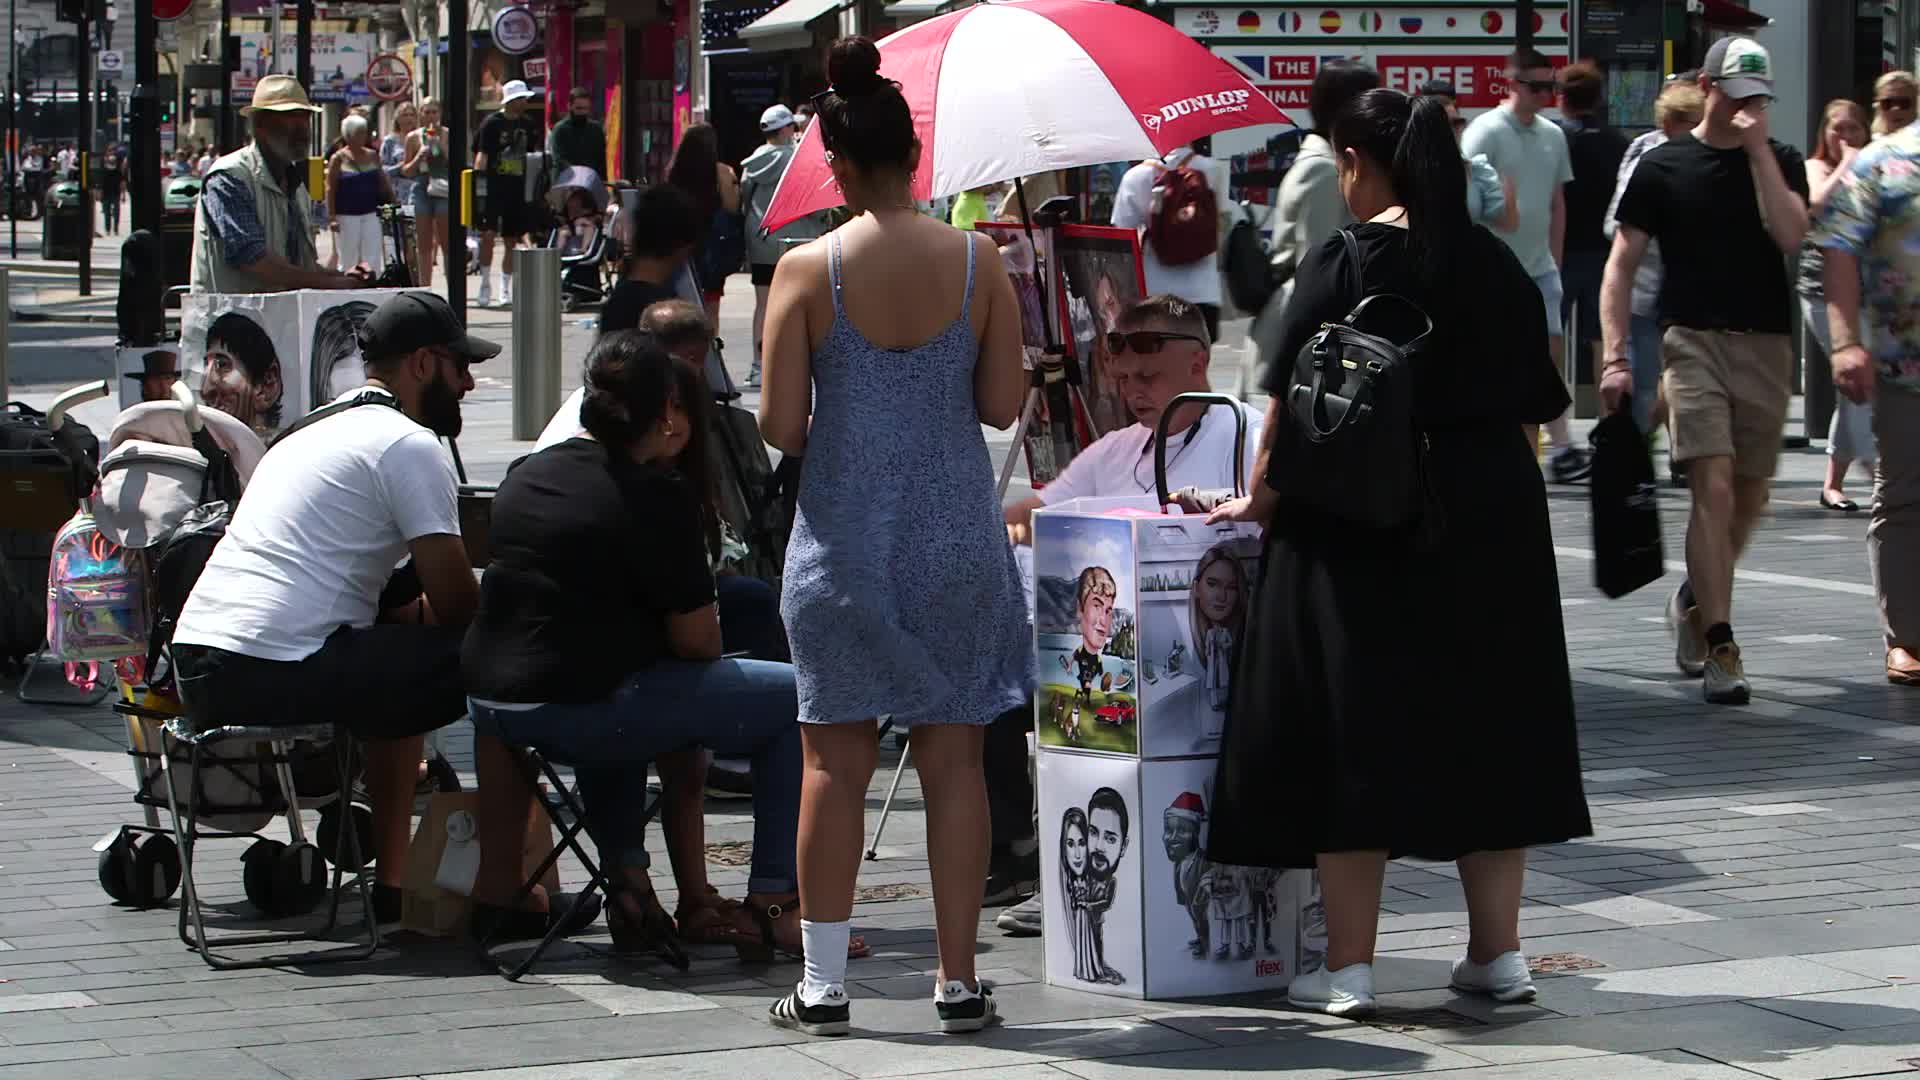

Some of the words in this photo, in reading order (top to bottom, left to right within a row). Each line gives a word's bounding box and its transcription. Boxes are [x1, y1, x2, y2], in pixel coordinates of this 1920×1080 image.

[1275, 61, 1310, 74] THE
[1159, 89, 1250, 122] DUNLOP
[1211, 104, 1249, 115] SPORT
